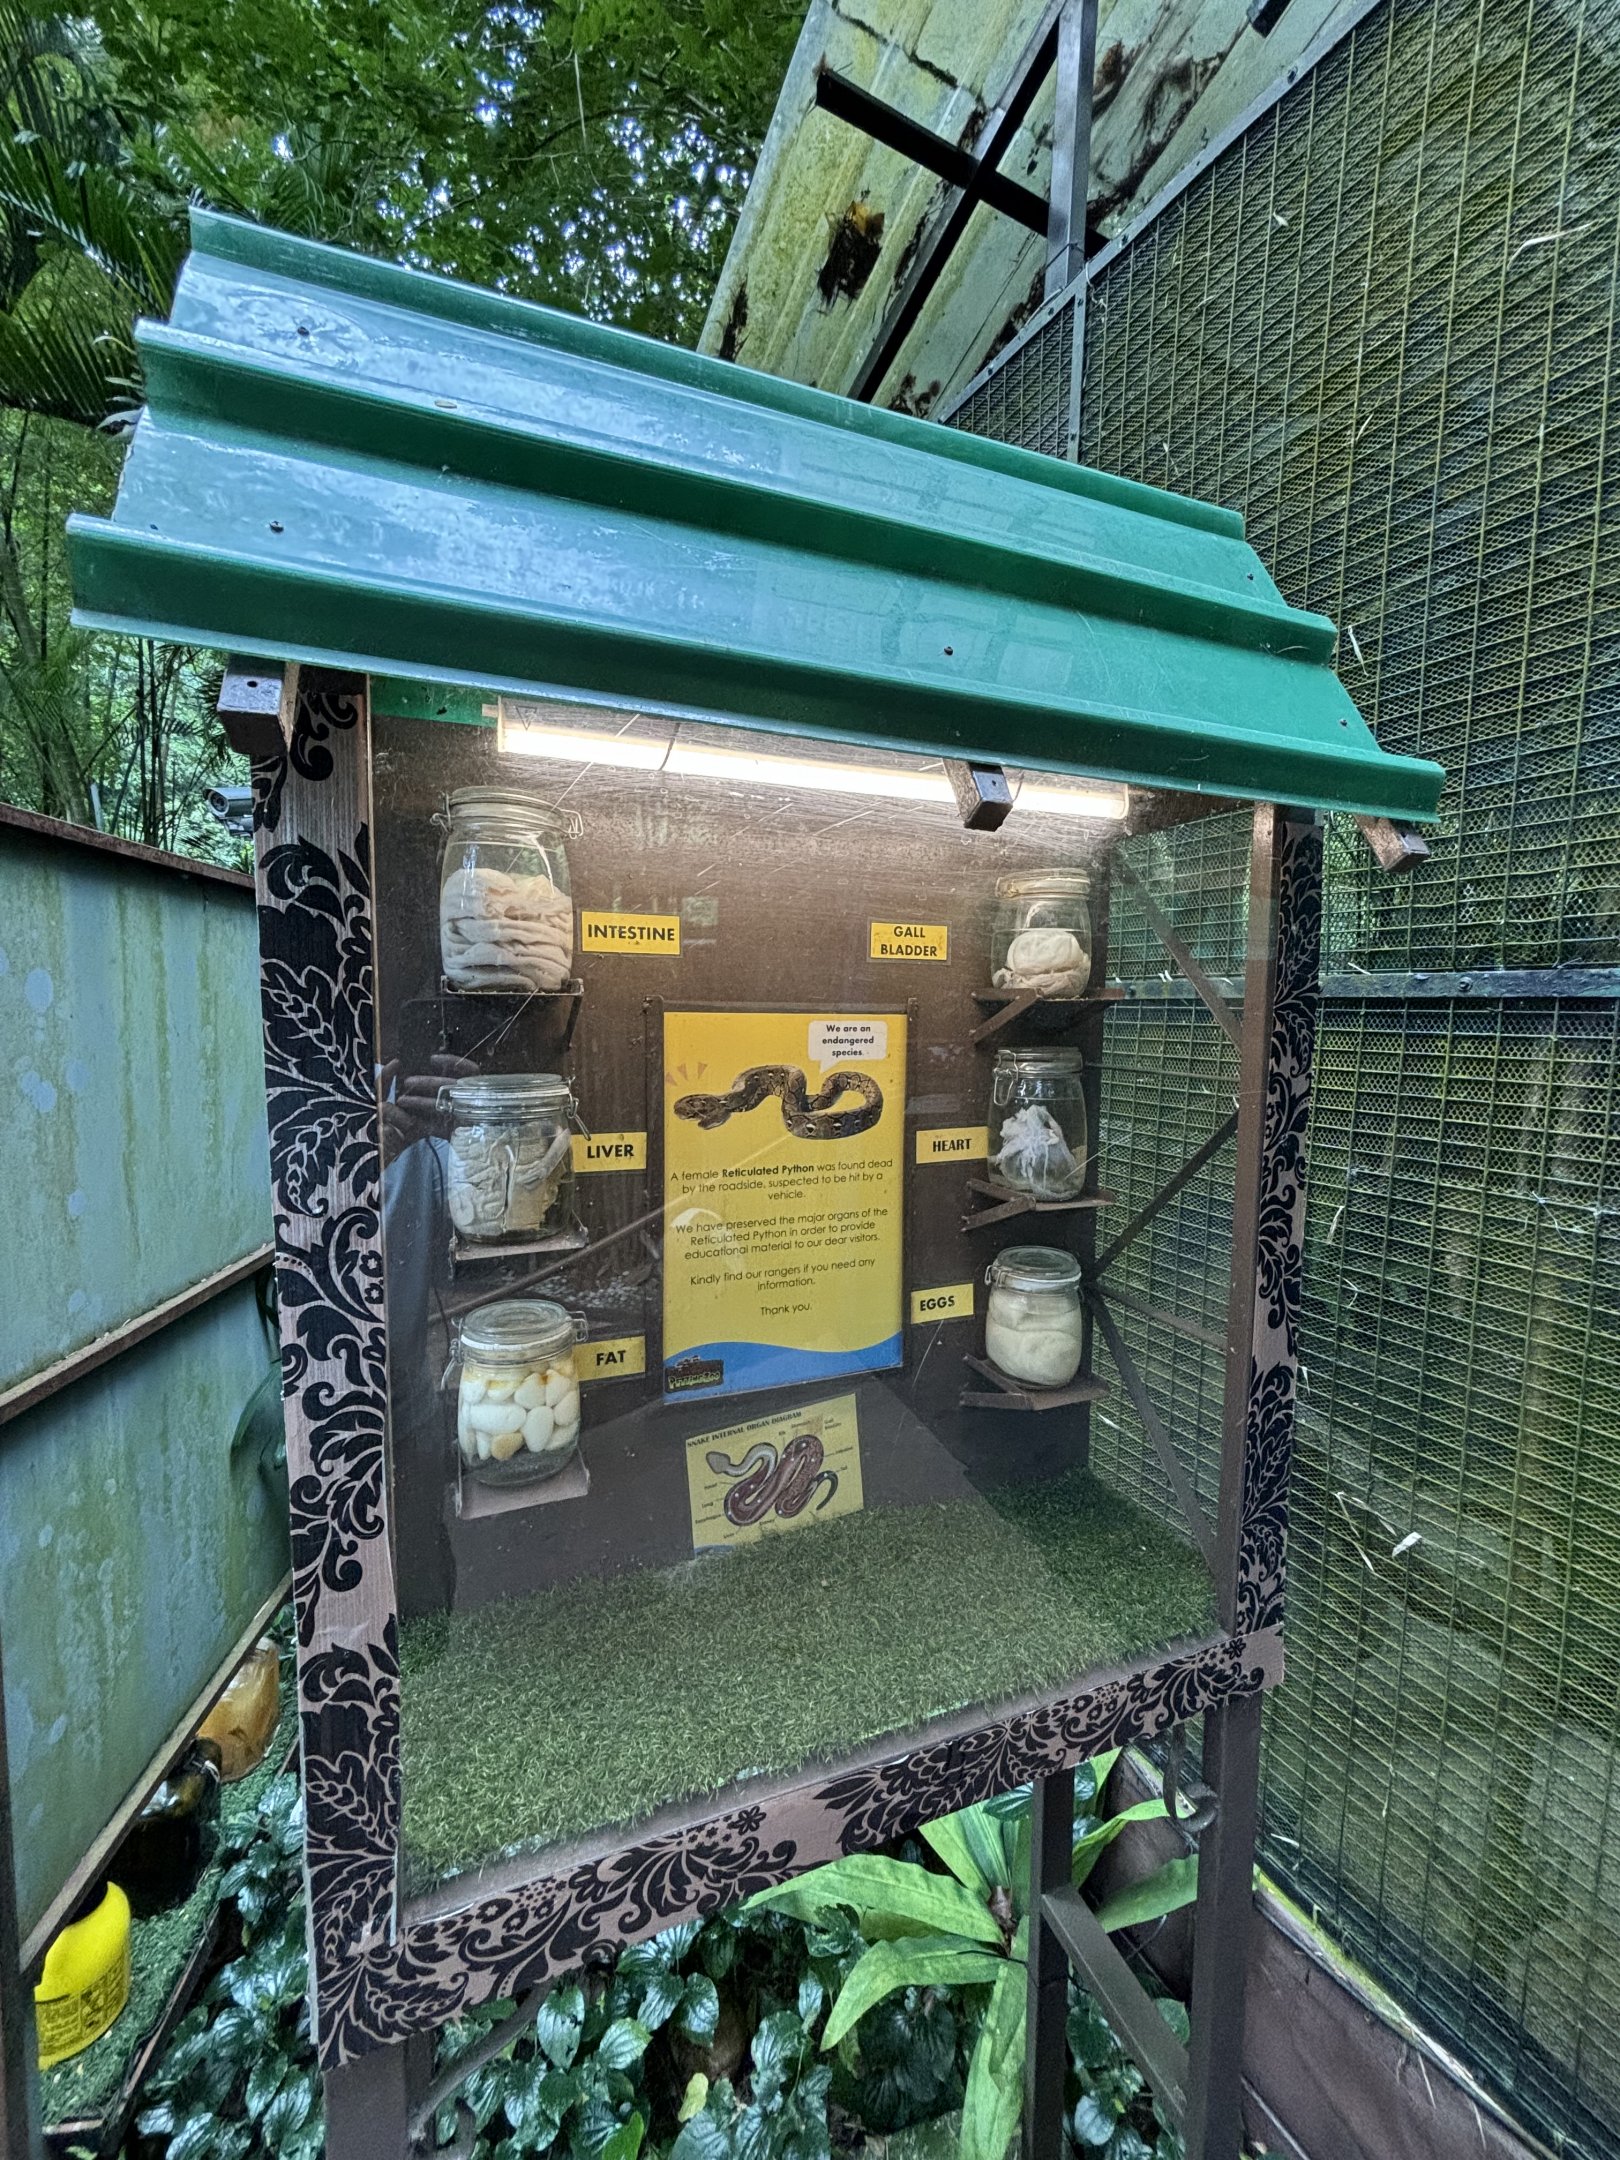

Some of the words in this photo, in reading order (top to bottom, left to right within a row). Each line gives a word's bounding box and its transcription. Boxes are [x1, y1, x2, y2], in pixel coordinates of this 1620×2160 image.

[587, 924, 675, 941] INTESTINE
[894, 926, 926, 938] GALL
[880, 944, 938, 957] BLADDER
[826, 1024, 841, 1032] We
[822, 1036, 874, 1046] endangered
[587, 1144, 634, 1159] LIVER
[932, 1138, 972, 1152] HEART
[670, 1172, 679, 1181] A
[682, 1170, 719, 1181] female
[722, 1165, 779, 1178] Reticulated
[782, 1164, 814, 1175] Python
[817, 1163, 835, 1171] was
[838, 1160, 865, 1170] found
[867, 1159, 893, 1169] dead
[682, 1185, 696, 1195] by
[699, 1184, 716, 1193] the
[768, 1176, 819, 1188] suspected
[821, 1176, 831, 1184] to
[834, 1174, 847, 1183] be
[849, 1173, 860, 1182] hit
[862, 1172, 874, 1182] by
[877, 1172, 883, 1180] a
[768, 1189, 806, 1200] vehicle.
[675, 1224, 693, 1233] We
[696, 1222, 723, 1232] have
[726, 1217, 776, 1231] preserved
[779, 1215, 795, 1225] the
[798, 1213, 825, 1224] major
[827, 1210, 860, 1222] organs
[861, 1208, 871, 1218] of
[873, 1207, 888, 1217] the
[690, 1232, 750, 1246] Reticulated
[753, 1230, 787, 1241] Python
[789, 1228, 798, 1237] in
[800, 1225, 826, 1236] order
[829, 1224, 838, 1233] to
[840, 1221, 876, 1233] provide
[684, 1245, 748, 1260] educational
[751, 1240, 792, 1253] material
[794, 1241, 804, 1249] to
[807, 1239, 822, 1248] our
[824, 1237, 847, 1246] dear
[849, 1233, 880, 1243] visitors.
[690, 1273, 721, 1286] Kindly
[724, 1271, 743, 1281] find
[745, 1270, 762, 1280] our
[764, 1265, 801, 1278] rangers
[803, 1263, 811, 1273] if
[811, 1262, 829, 1273] you
[831, 1259, 856, 1270] need
[858, 1257, 875, 1268] any
[757, 1277, 816, 1291] information.
[761, 1304, 790, 1316] Thank
[792, 1302, 812, 1314] you.
[920, 1295, 956, 1312] EGGS
[596, 1349, 626, 1366] FAT
[687, 1437, 710, 1447] SNAKE
[712, 1427, 745, 1441] INTERNAL
[746, 1420, 770, 1431] ORGAN
[771, 1411, 802, 1424] DIAGRAM
